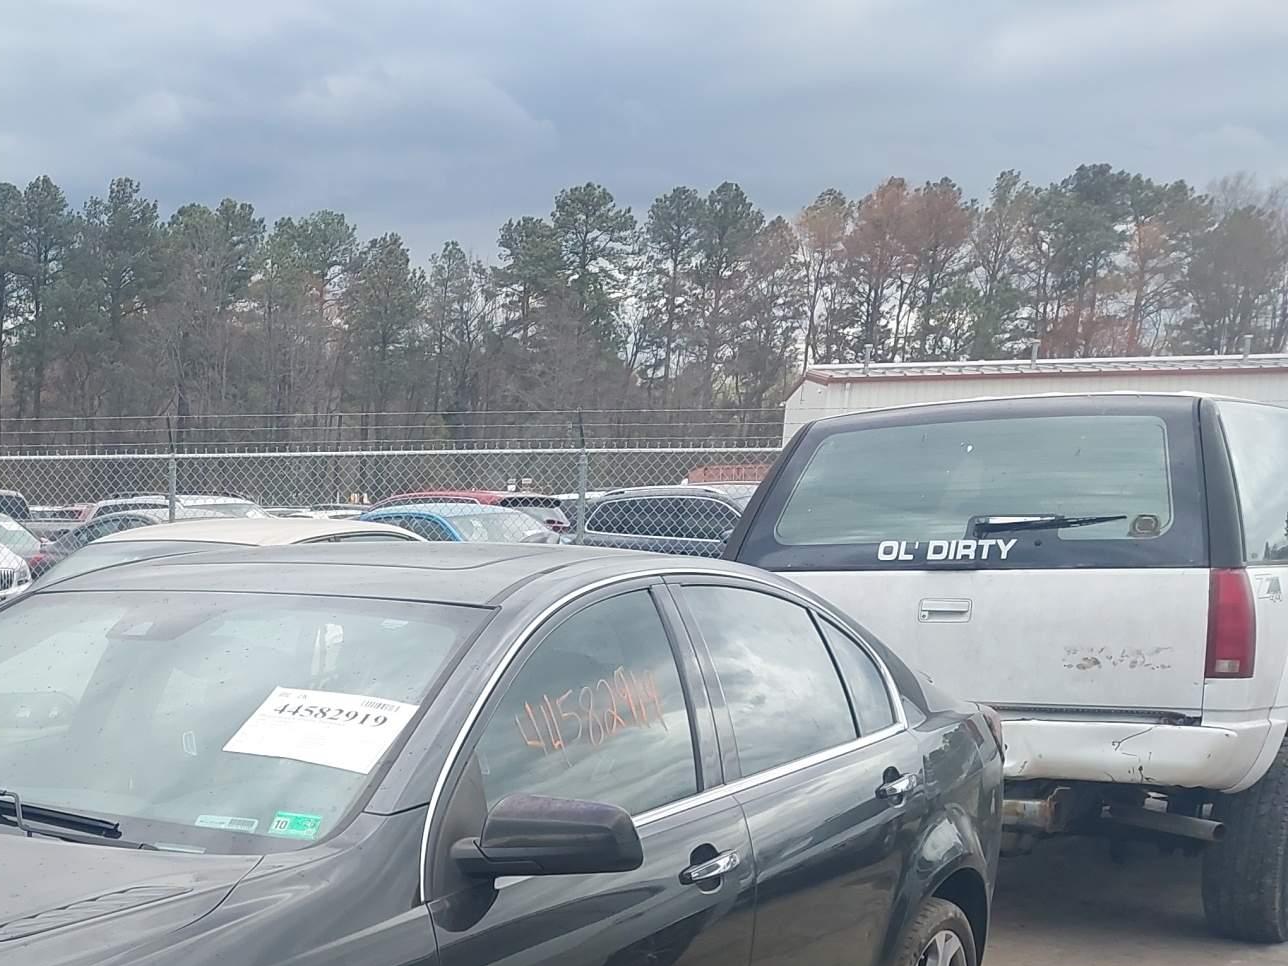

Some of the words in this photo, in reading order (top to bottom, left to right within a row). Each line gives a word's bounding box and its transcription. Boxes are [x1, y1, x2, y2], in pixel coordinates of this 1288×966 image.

[878, 540, 919, 561] OL'
[926, 538, 1018, 560] DIRTY
[274, 703, 388, 728] 44582919
[274, 820, 288, 830] 10
